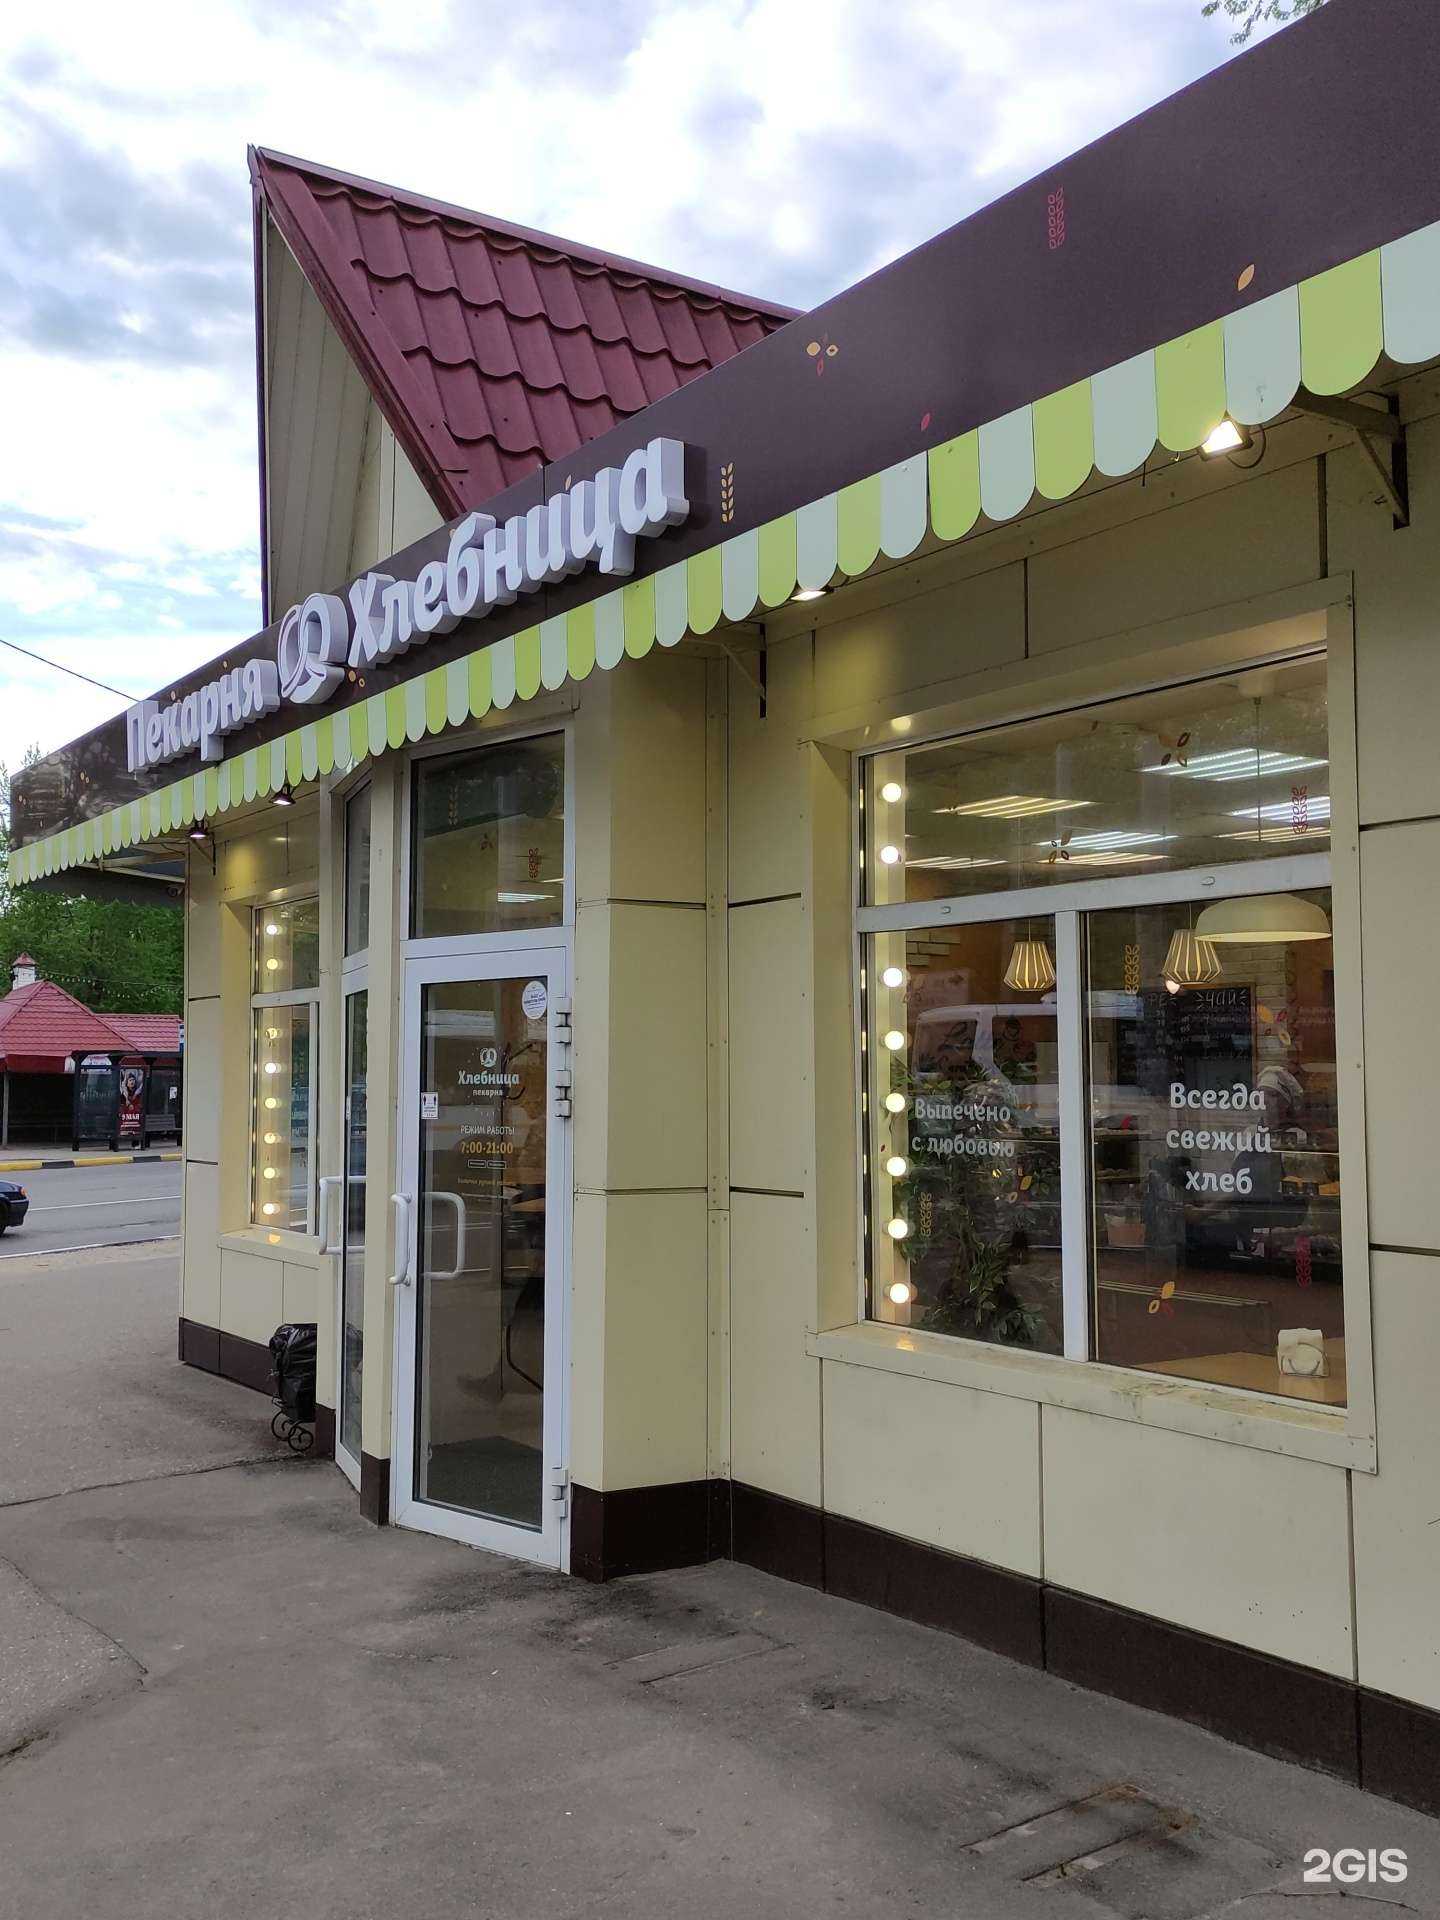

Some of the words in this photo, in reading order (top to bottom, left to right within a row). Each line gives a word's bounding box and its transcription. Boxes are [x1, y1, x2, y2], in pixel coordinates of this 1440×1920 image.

[126, 658, 279, 773] Пекарня
[348, 437, 690, 669] Хлебница
[458, 1070, 520, 1088] Хлебница
[1170, 1082, 1267, 1110] Всегда
[915, 1098, 1011, 1122] Выпечено
[460, 1125, 486, 1135] РЕЖИМ
[487, 1126, 515, 1136] РАБОТЫ
[1166, 1125, 1273, 1153] свежий
[911, 1136, 921, 1152] с
[927, 1134, 1015, 1158] любовью
[1185, 1167, 1253, 1194] хлеб
